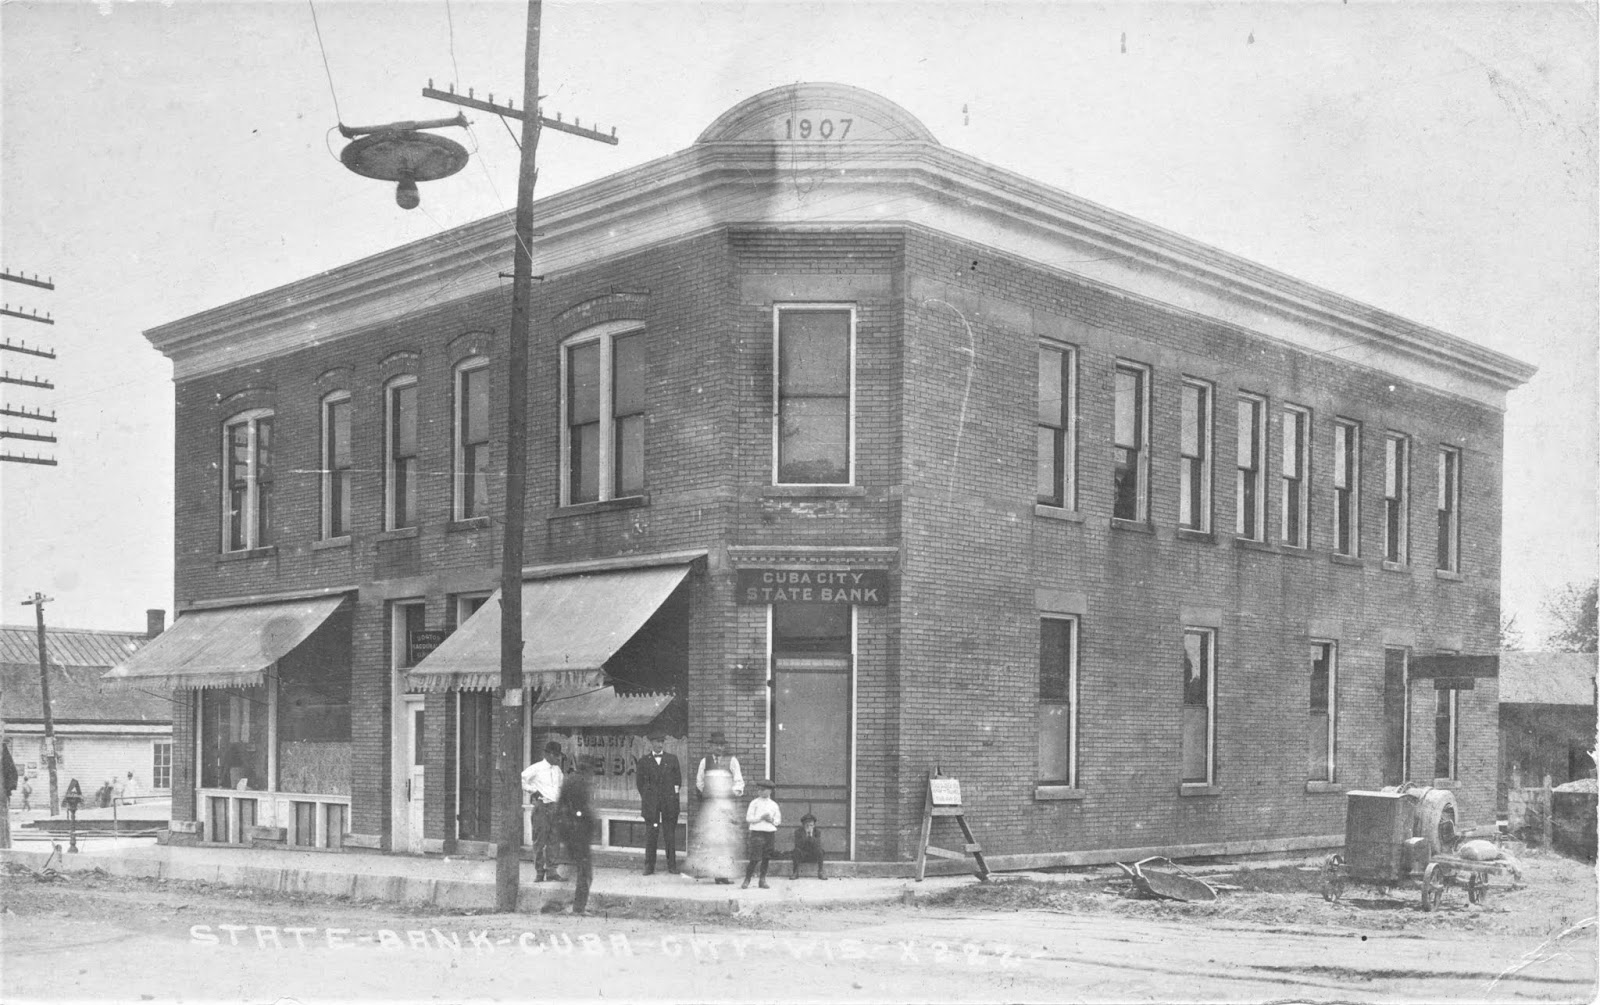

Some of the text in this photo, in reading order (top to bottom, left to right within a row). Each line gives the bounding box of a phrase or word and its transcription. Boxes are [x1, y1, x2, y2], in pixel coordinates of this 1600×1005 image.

[786, 118, 853, 139] 1907
[763, 572, 864, 584] CUBA CITY
[746, 587, 878, 602] STATE BANK
[577, 735, 635, 748] CUBA CITY
[614, 755, 638, 776] BA
